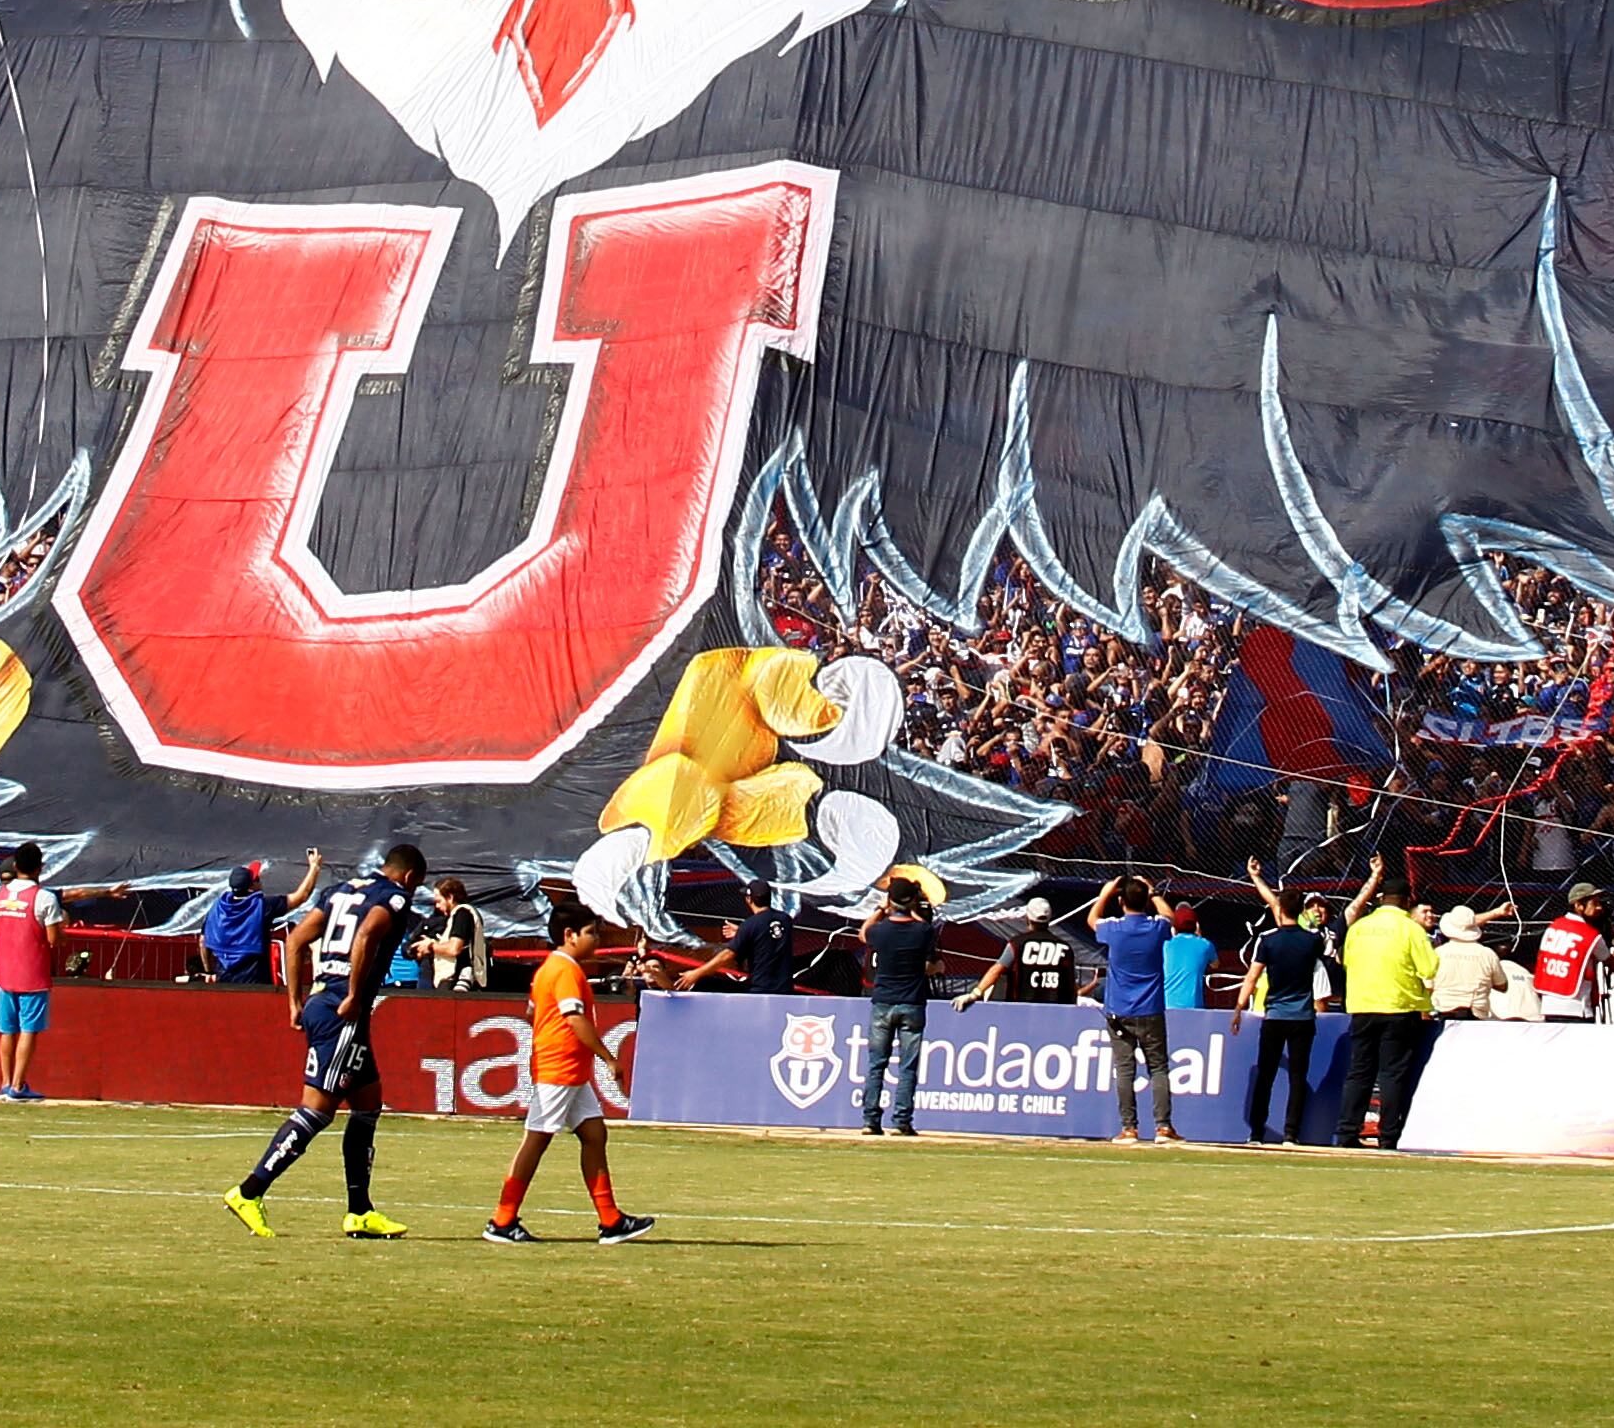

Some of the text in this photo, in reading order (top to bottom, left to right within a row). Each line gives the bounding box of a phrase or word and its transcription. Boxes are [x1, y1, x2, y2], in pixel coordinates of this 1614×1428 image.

[52, 159, 840, 786] U
[322, 892, 366, 954] 15
[1023, 940, 1070, 966] CDF
[347, 1043, 368, 1071] 15
[845, 1024, 1225, 1097] tndaofial
[788, 1060, 824, 1095] U
[850, 1088, 891, 1108] CB
[998, 1092, 1019, 1113] DE
[1022, 1093, 1067, 1115] CHILE
